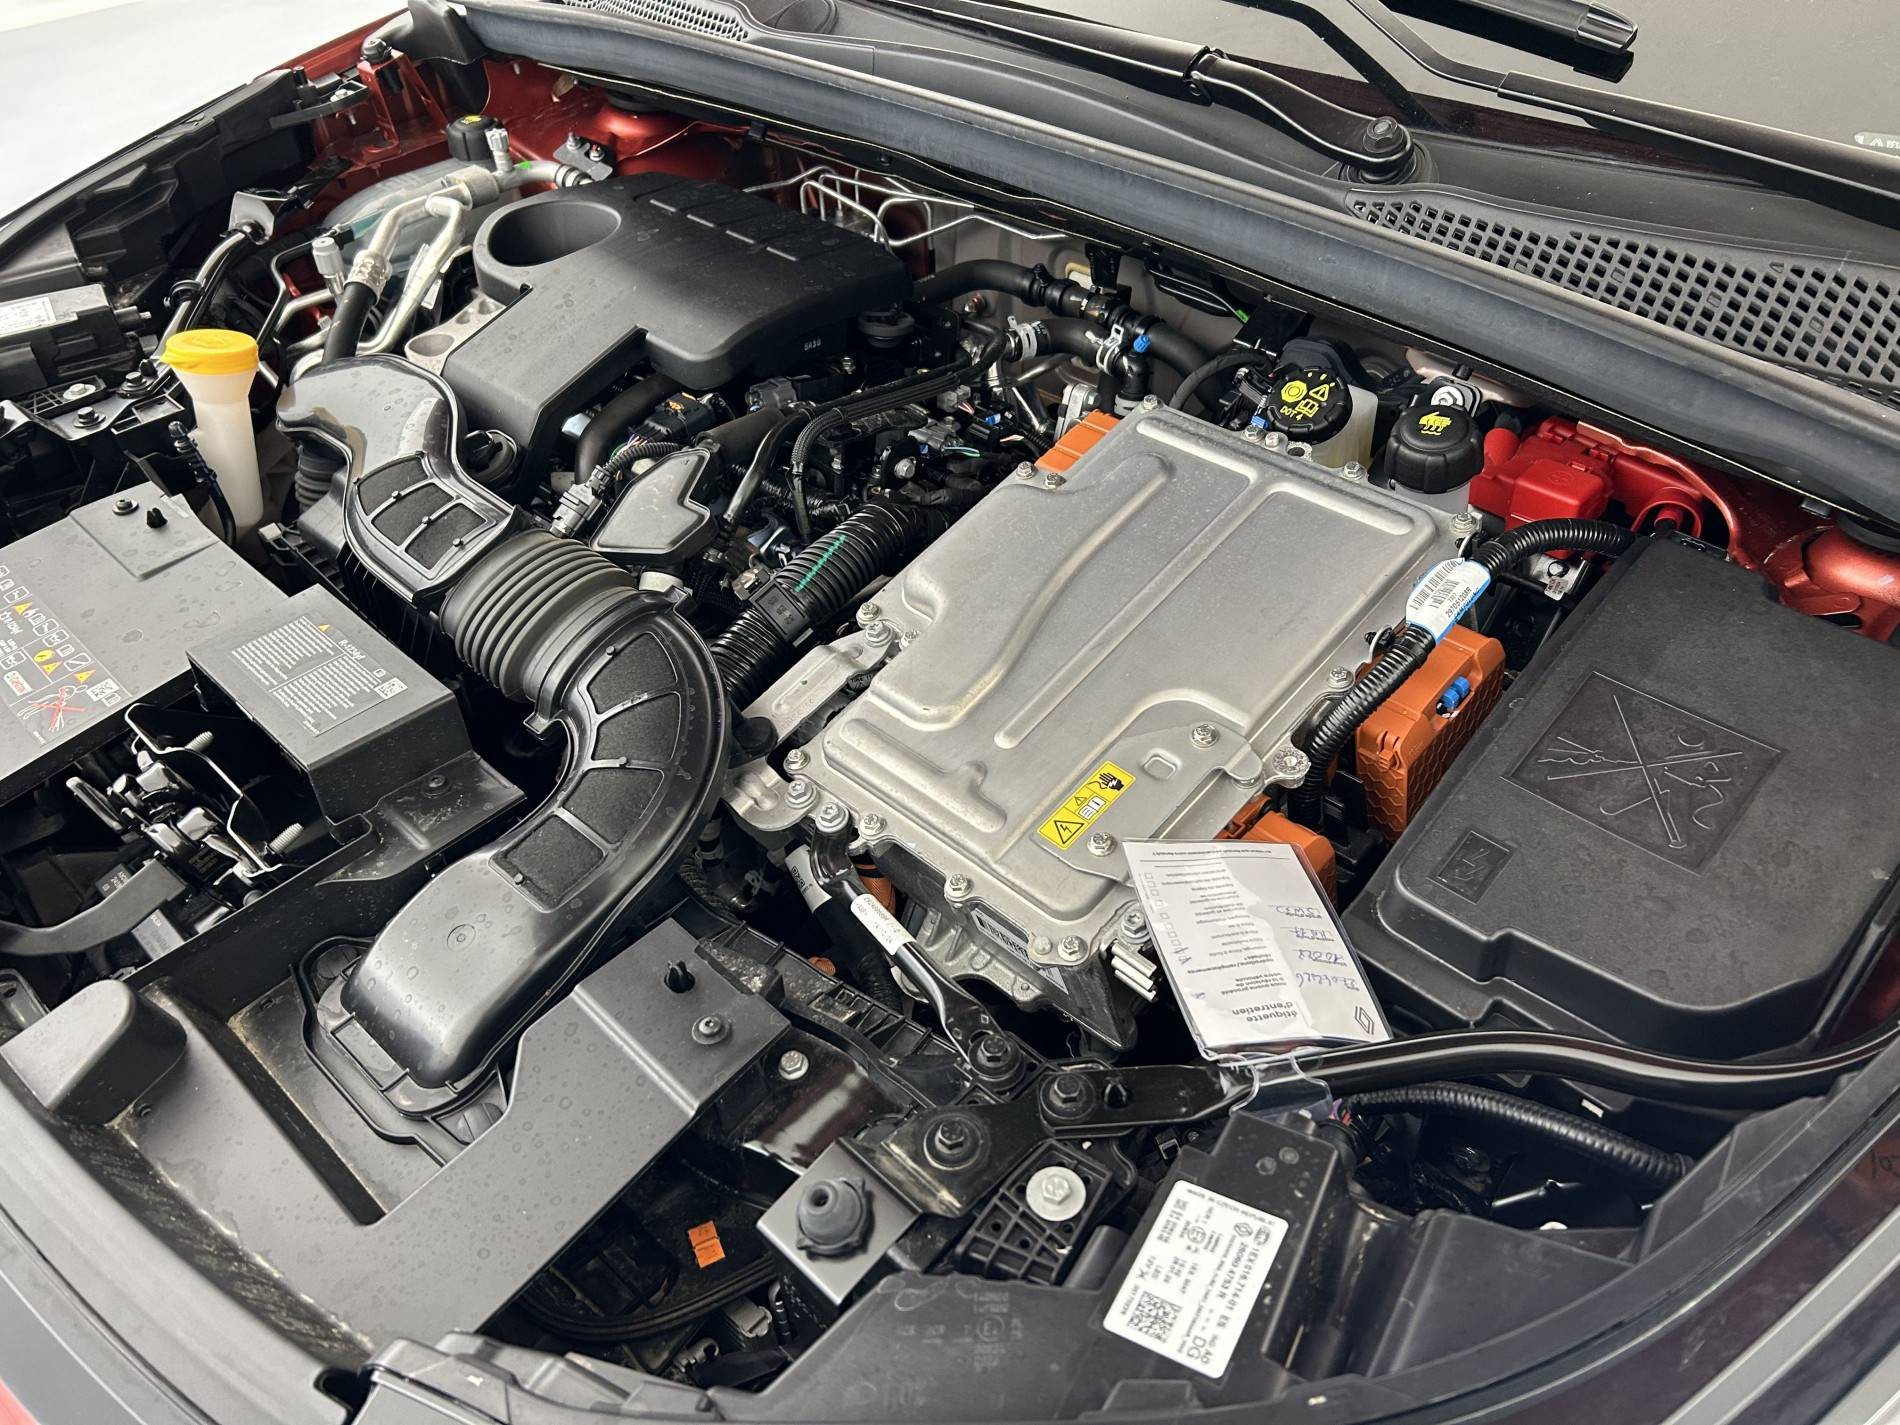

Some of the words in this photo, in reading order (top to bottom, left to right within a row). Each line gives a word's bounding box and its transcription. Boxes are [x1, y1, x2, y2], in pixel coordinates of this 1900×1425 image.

[1279, 405, 1297, 418] DOT
[1232, 1001, 1293, 1016] d'entretien
[1187, 1335, 1207, 1360] DG
